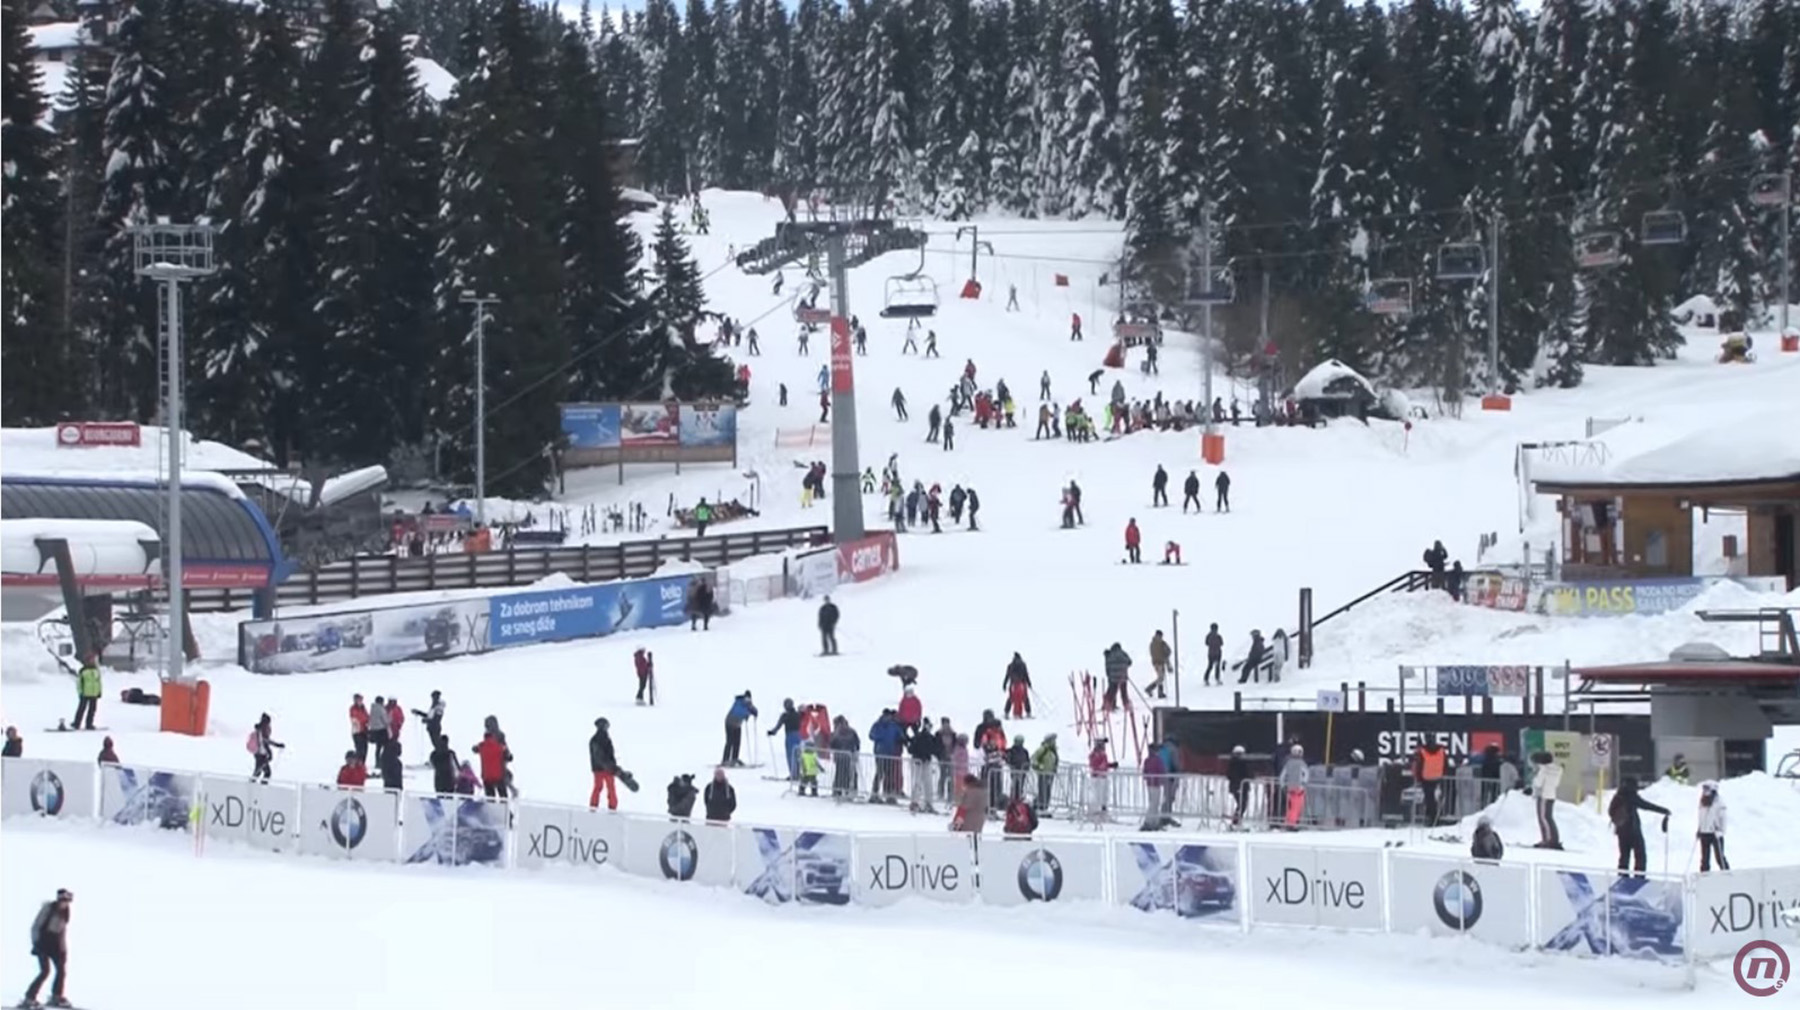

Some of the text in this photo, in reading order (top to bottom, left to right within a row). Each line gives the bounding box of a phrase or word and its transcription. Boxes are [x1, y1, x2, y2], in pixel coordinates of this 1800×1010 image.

[500, 595, 593, 618] Za dobrom tehnikom
[660, 584, 682, 601] beko
[1586, 586, 1635, 612] PASS
[501, 625, 512, 637] se
[512, 622, 537, 637] sneg
[211, 795, 286, 836] xDrive
[528, 825, 609, 864] xDrive
[869, 854, 959, 891] xDrive
[1266, 867, 1365, 909] xDrive
[1710, 889, 1800, 934] xDri
